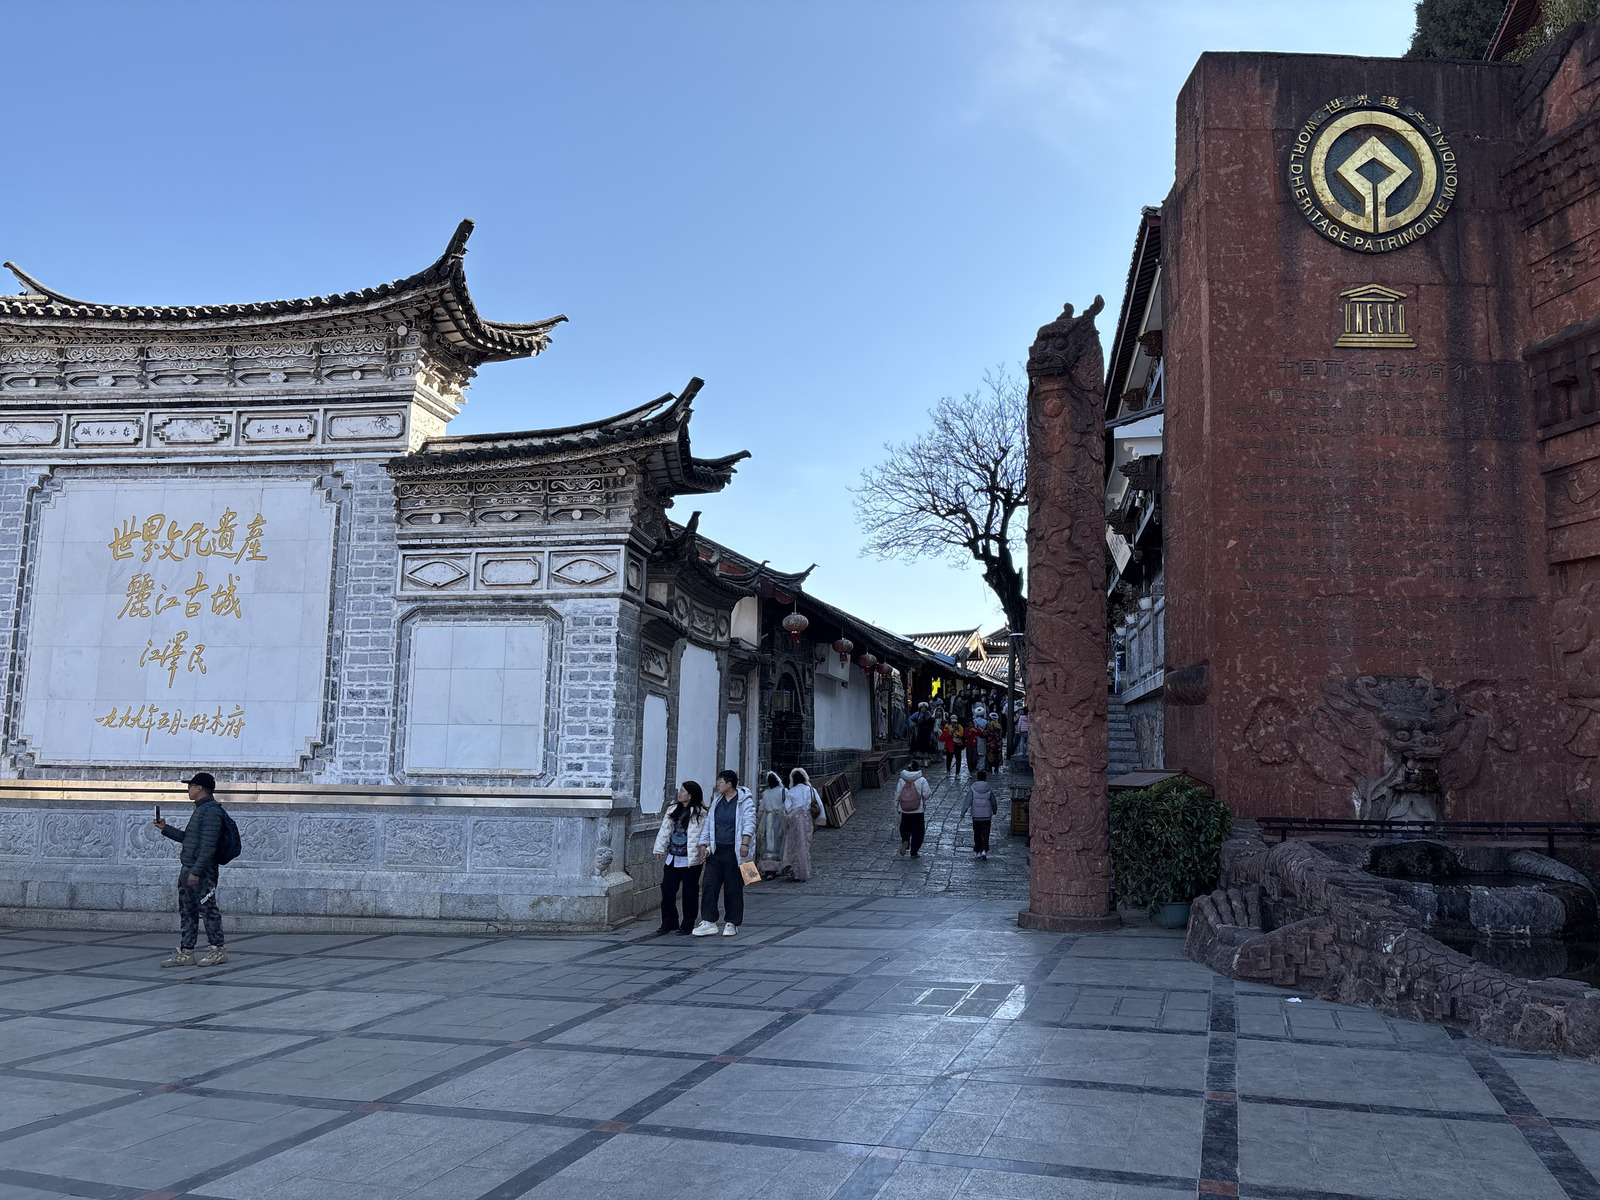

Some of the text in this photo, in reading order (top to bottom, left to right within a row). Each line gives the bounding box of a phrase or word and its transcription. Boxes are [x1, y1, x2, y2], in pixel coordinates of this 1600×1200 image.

[1291, 120, 1351, 245] WORLD HERITAGE
[1353, 125, 1458, 251] PATRIMOINE MONDIAL
[1344, 303, 1405, 334] UNESCO
[1277, 358, 1473, 382] 中国丽江古城简介
